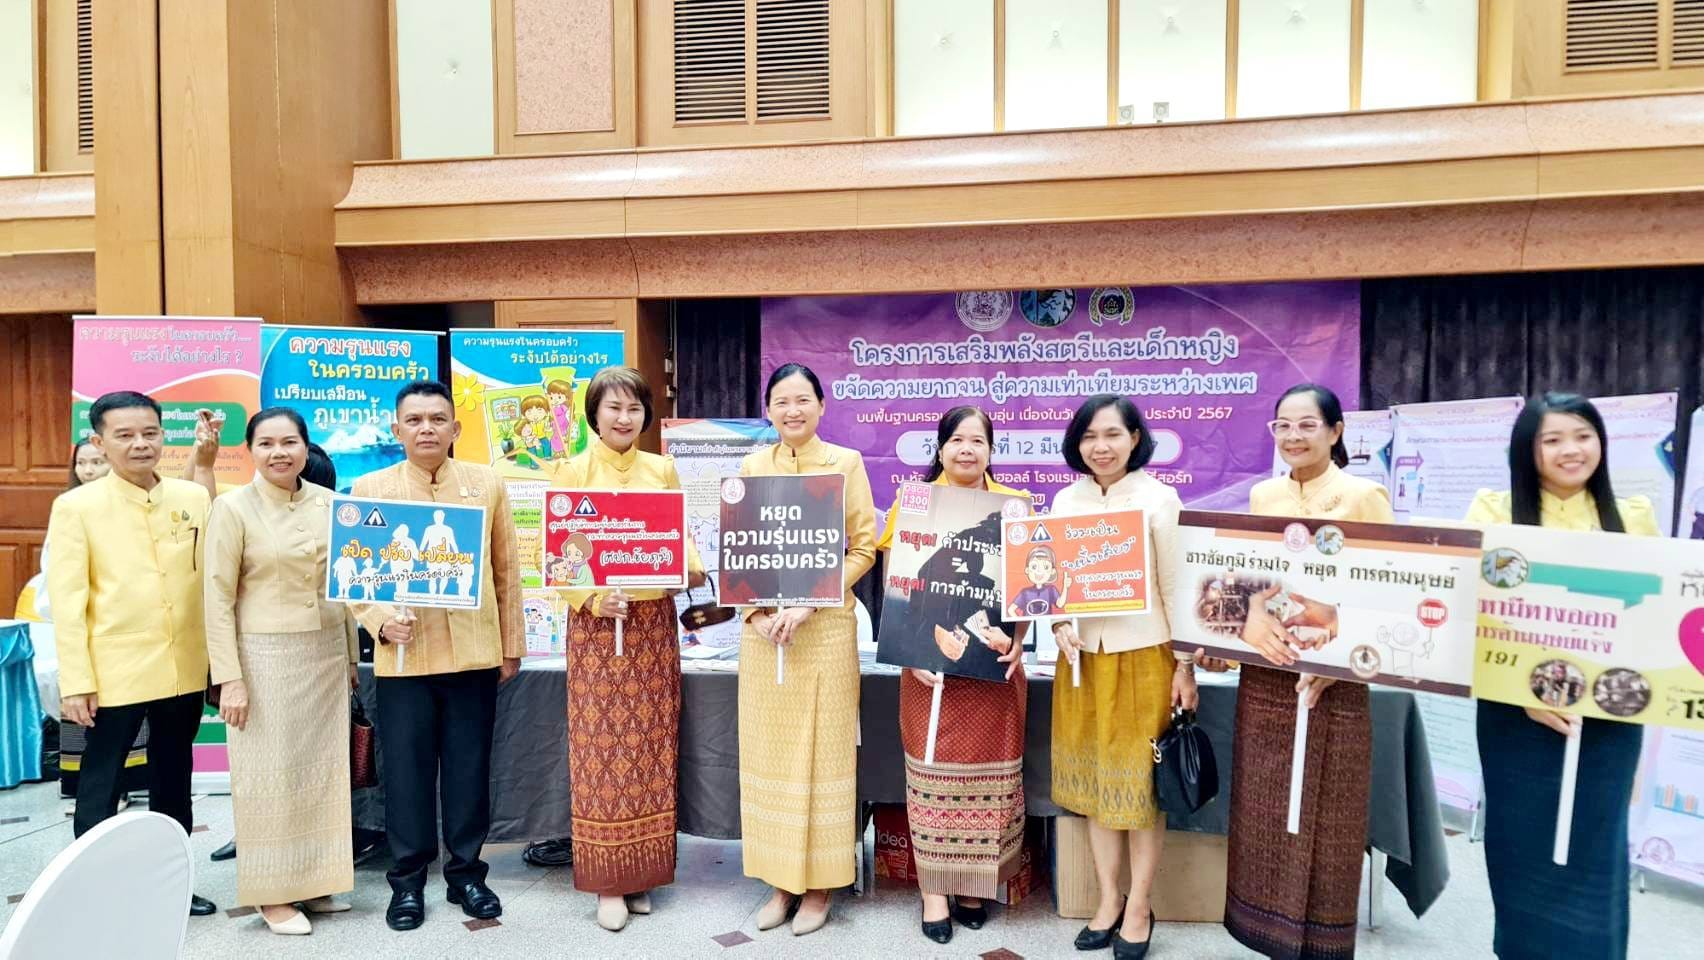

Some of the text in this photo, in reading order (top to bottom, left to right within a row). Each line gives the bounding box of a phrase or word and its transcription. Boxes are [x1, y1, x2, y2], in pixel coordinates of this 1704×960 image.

[290, 337, 411, 360] ความรุนแรง
[510, 350, 608, 365] ระงับได้อย่างไร
[852, 331, 1238, 365] โครงการเสริมพลังสตรีและเด็กหญิง
[308, 359, 429, 381] ในครอบครัว
[274, 383, 367, 401] เปรียบเสมือน
[832, 369, 1257, 404] ขจัดความยากจน สู่ความเท่าเทียมระหว่างเพศ
[1144, 407, 1192, 421] ประจำปี
[1197, 407, 1233, 420] 2567
[1016, 441, 1034, 455] 12
[903, 495, 928, 506] 1300
[760, 505, 802, 527] หยุด
[341, 537, 473, 564] เปิด ปรับ เปลี่ยน
[899, 530, 938, 551] หยุด!
[723, 547, 838, 571] ในครอบครัว
[348, 564, 464, 588] ความรุนแรงในครอบครัว
[1303, 561, 1338, 582] หยุด
[889, 575, 926, 596] หยุด!
[1420, 606, 1446, 620] STOP
[1483, 649, 1519, 667] 191
